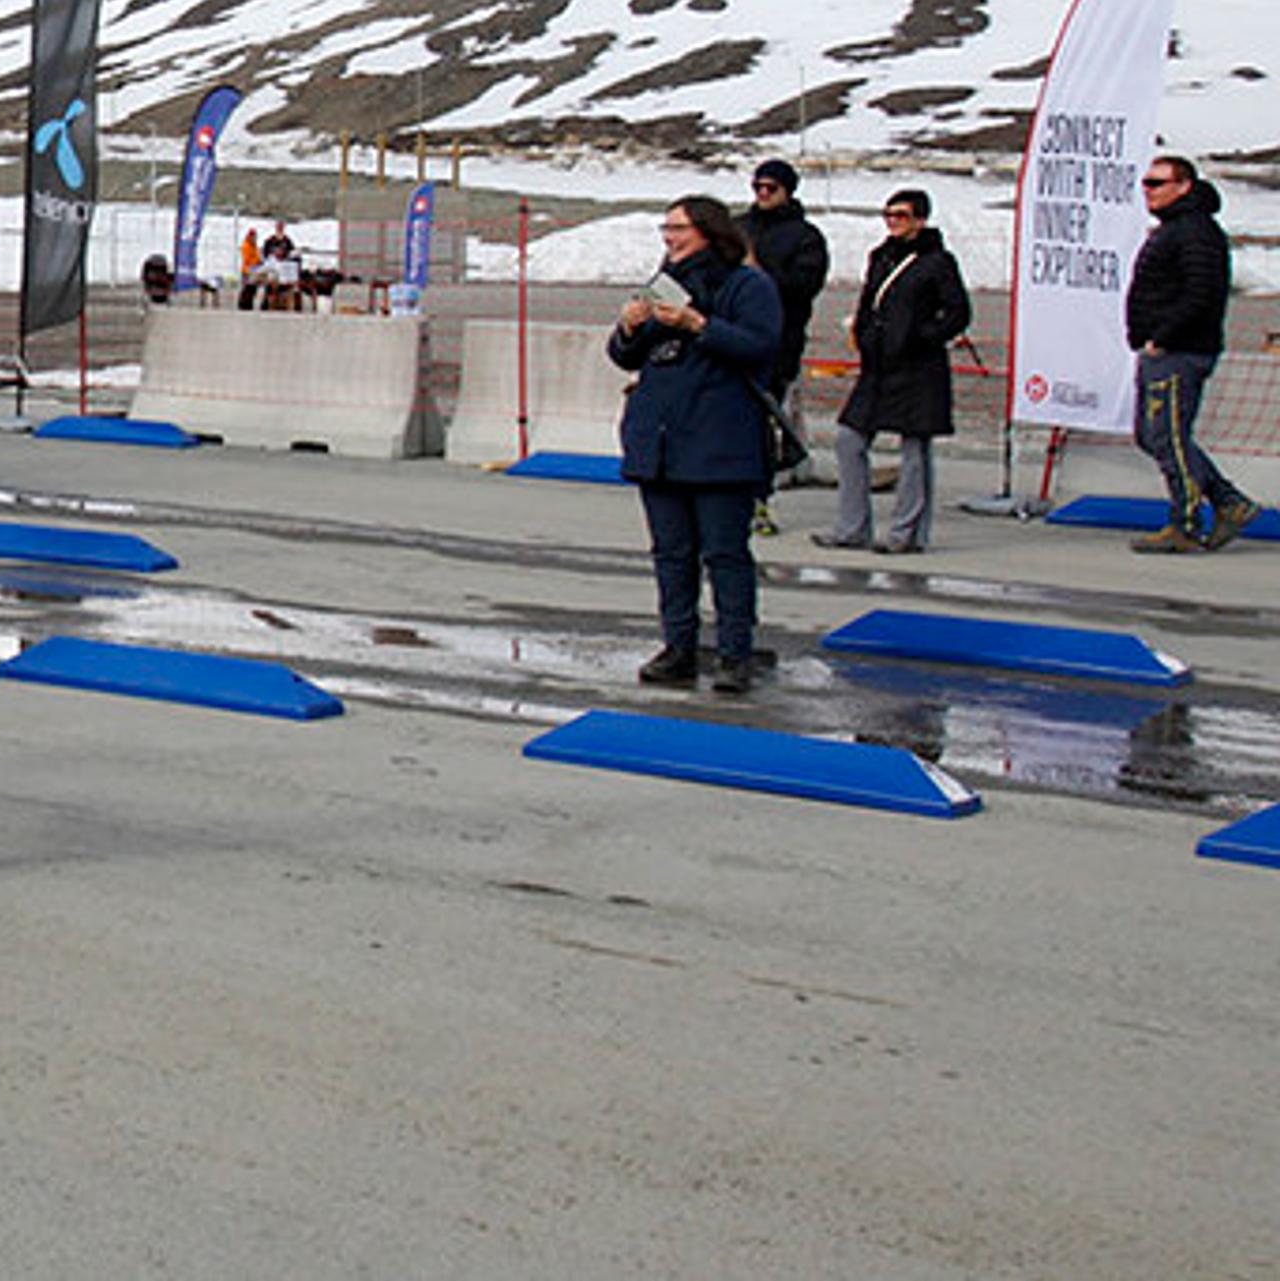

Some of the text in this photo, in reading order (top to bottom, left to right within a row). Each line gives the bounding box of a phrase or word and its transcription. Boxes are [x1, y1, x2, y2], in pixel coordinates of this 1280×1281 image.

[1040, 113, 1128, 160] CONNECT
[1037, 158, 1087, 200] WITH
[1033, 200, 1090, 244] INNER
[1031, 242, 1121, 293] EXPLORER
